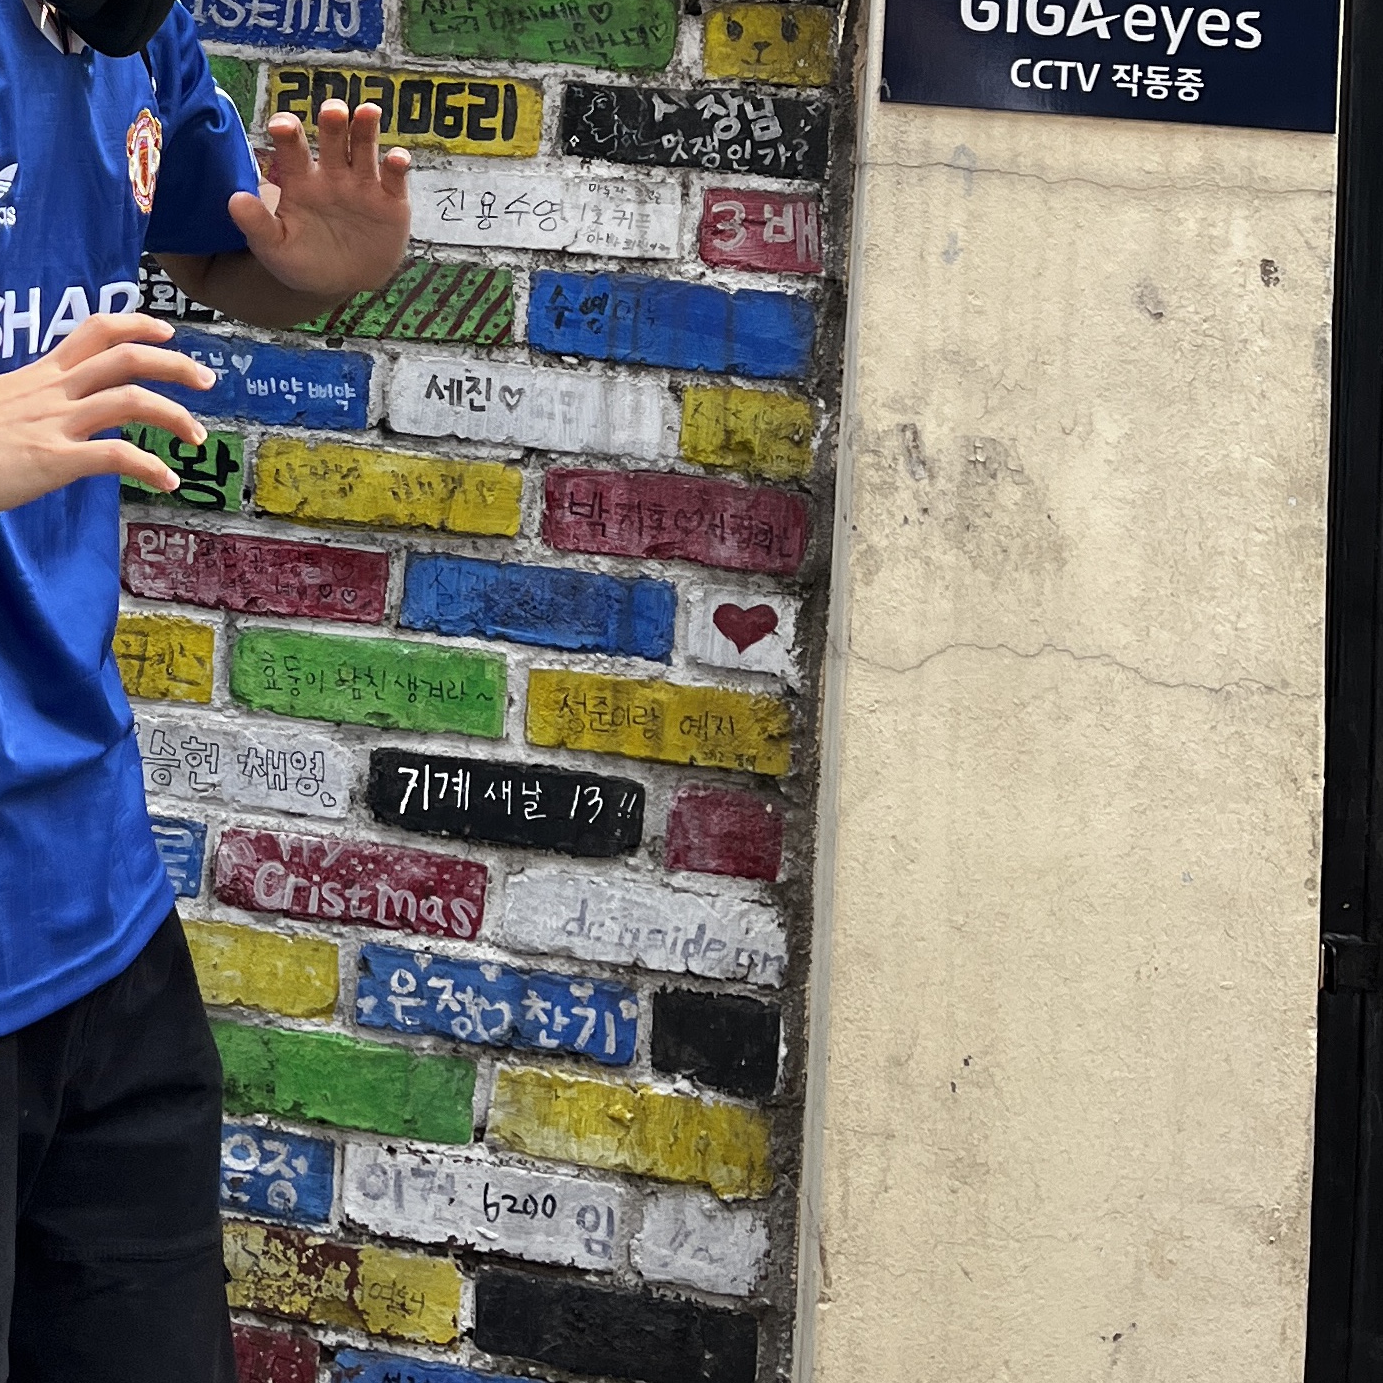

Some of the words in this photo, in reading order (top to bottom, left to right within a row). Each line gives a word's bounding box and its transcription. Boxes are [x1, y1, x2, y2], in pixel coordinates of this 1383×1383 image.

[1123, 3, 1262, 55] eyes
[1010, 58, 1101, 92] CCTV
[1111, 64, 1205, 102] 작동중
[246, 377, 357, 411] 삐약삐약
[425, 373, 493, 412] 세진
[483, 1182, 557, 1222] 6200
